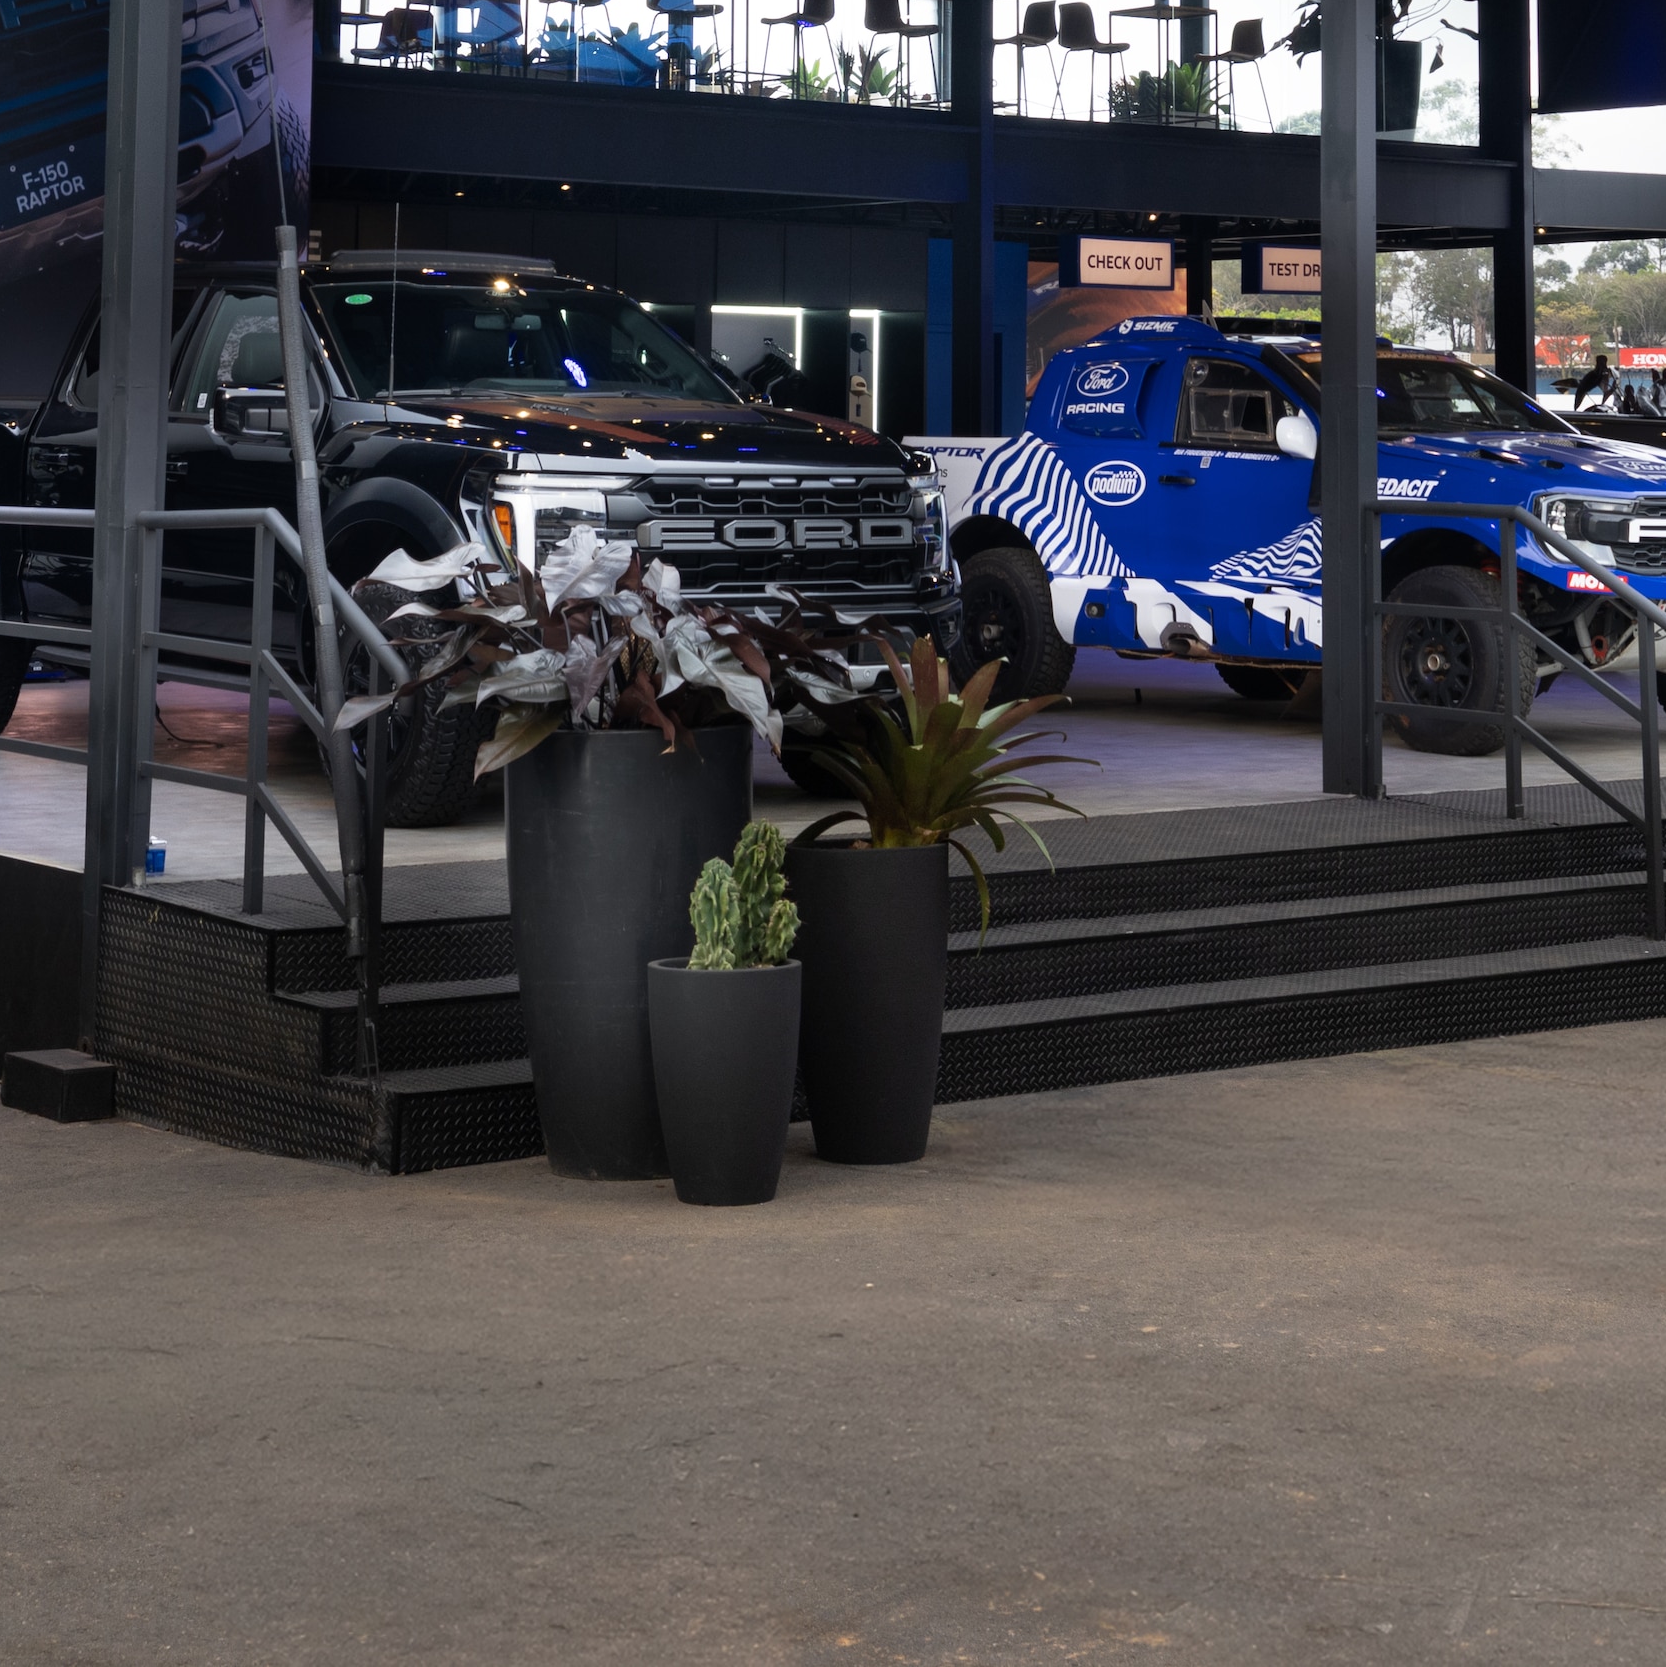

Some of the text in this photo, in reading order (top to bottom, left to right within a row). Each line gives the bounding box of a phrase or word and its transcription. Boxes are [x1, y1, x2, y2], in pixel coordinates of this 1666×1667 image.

[22, 161, 69, 190] F-150
[16, 176, 85, 213] RAPTOR
[1087, 254, 1163, 271] CHECK OUT
[1269, 263, 1299, 276] TEST
[1133, 322, 1179, 331] SIZMIC
[1084, 369, 1118, 390] Ford
[1066, 402, 1126, 415] RACING
[916, 446, 986, 462] APTOR
[1092, 474, 1137, 495] podium
[1377, 478, 1439, 497] EDACIT
[636, 519, 914, 548] FORD
